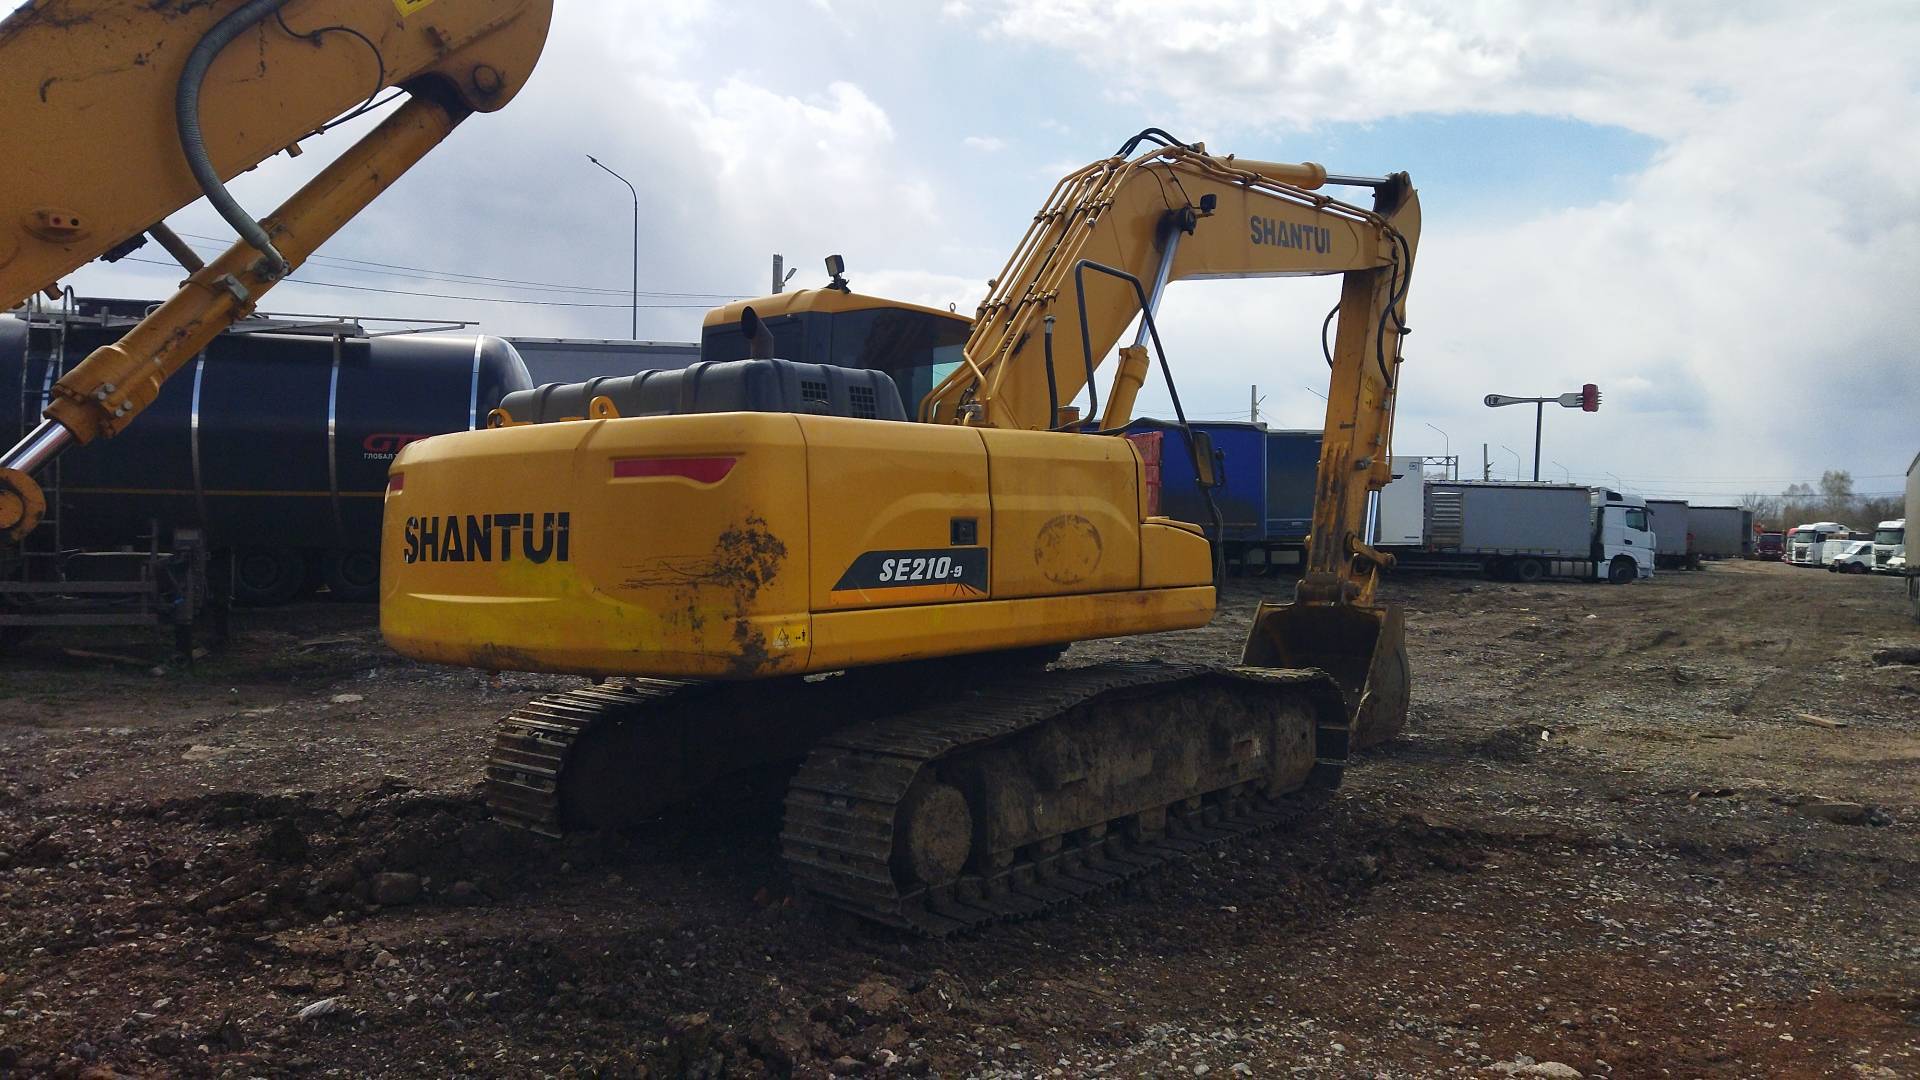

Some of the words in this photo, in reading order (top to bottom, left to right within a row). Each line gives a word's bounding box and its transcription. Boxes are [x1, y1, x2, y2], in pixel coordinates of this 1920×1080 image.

[1250, 215, 1331, 254] SHANTUI
[404, 512, 570, 564] SHANTUI
[879, 556, 963, 582] SE210-9
